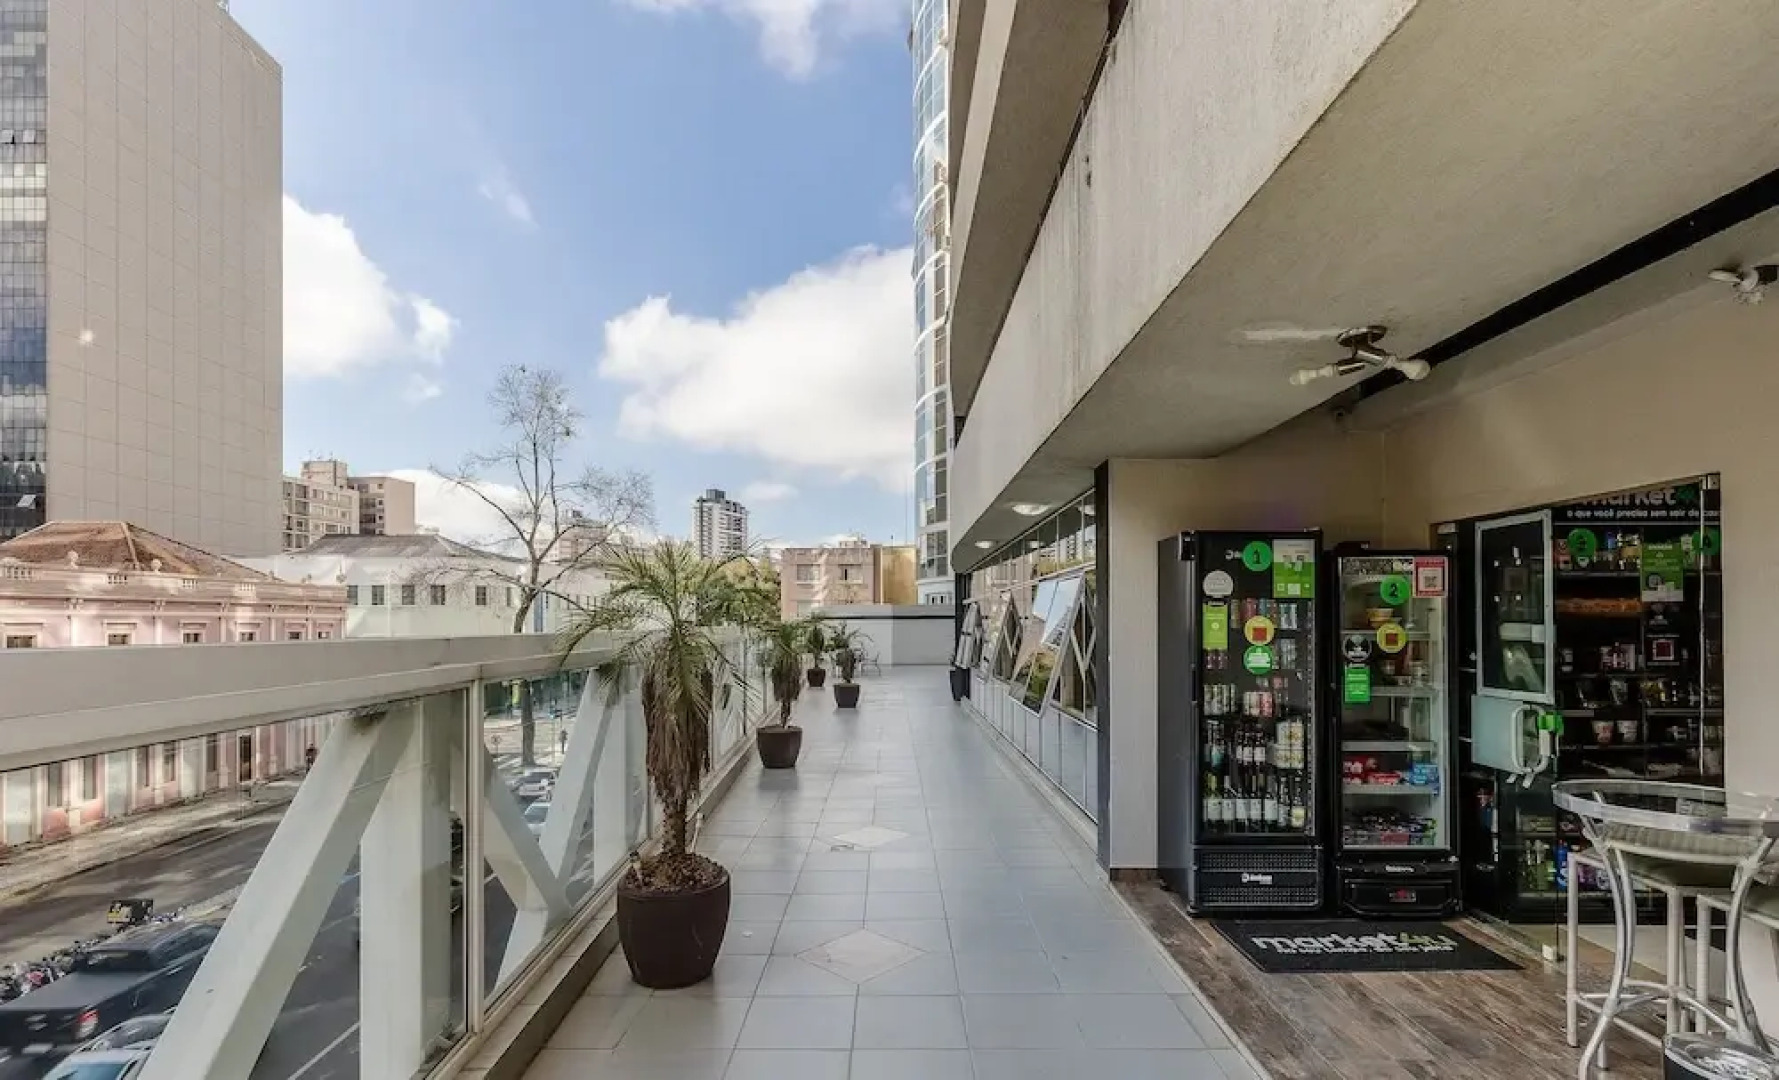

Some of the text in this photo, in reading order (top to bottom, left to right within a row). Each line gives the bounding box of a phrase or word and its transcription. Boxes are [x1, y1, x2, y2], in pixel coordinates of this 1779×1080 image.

[1574, 509, 1592, 519] que
[1616, 508, 1648, 519] precisa
[1650, 509, 1667, 518] sem
[1687, 507, 1700, 518] de
[1253, 549, 1261, 565] 1
[1389, 582, 1398, 597] 2
